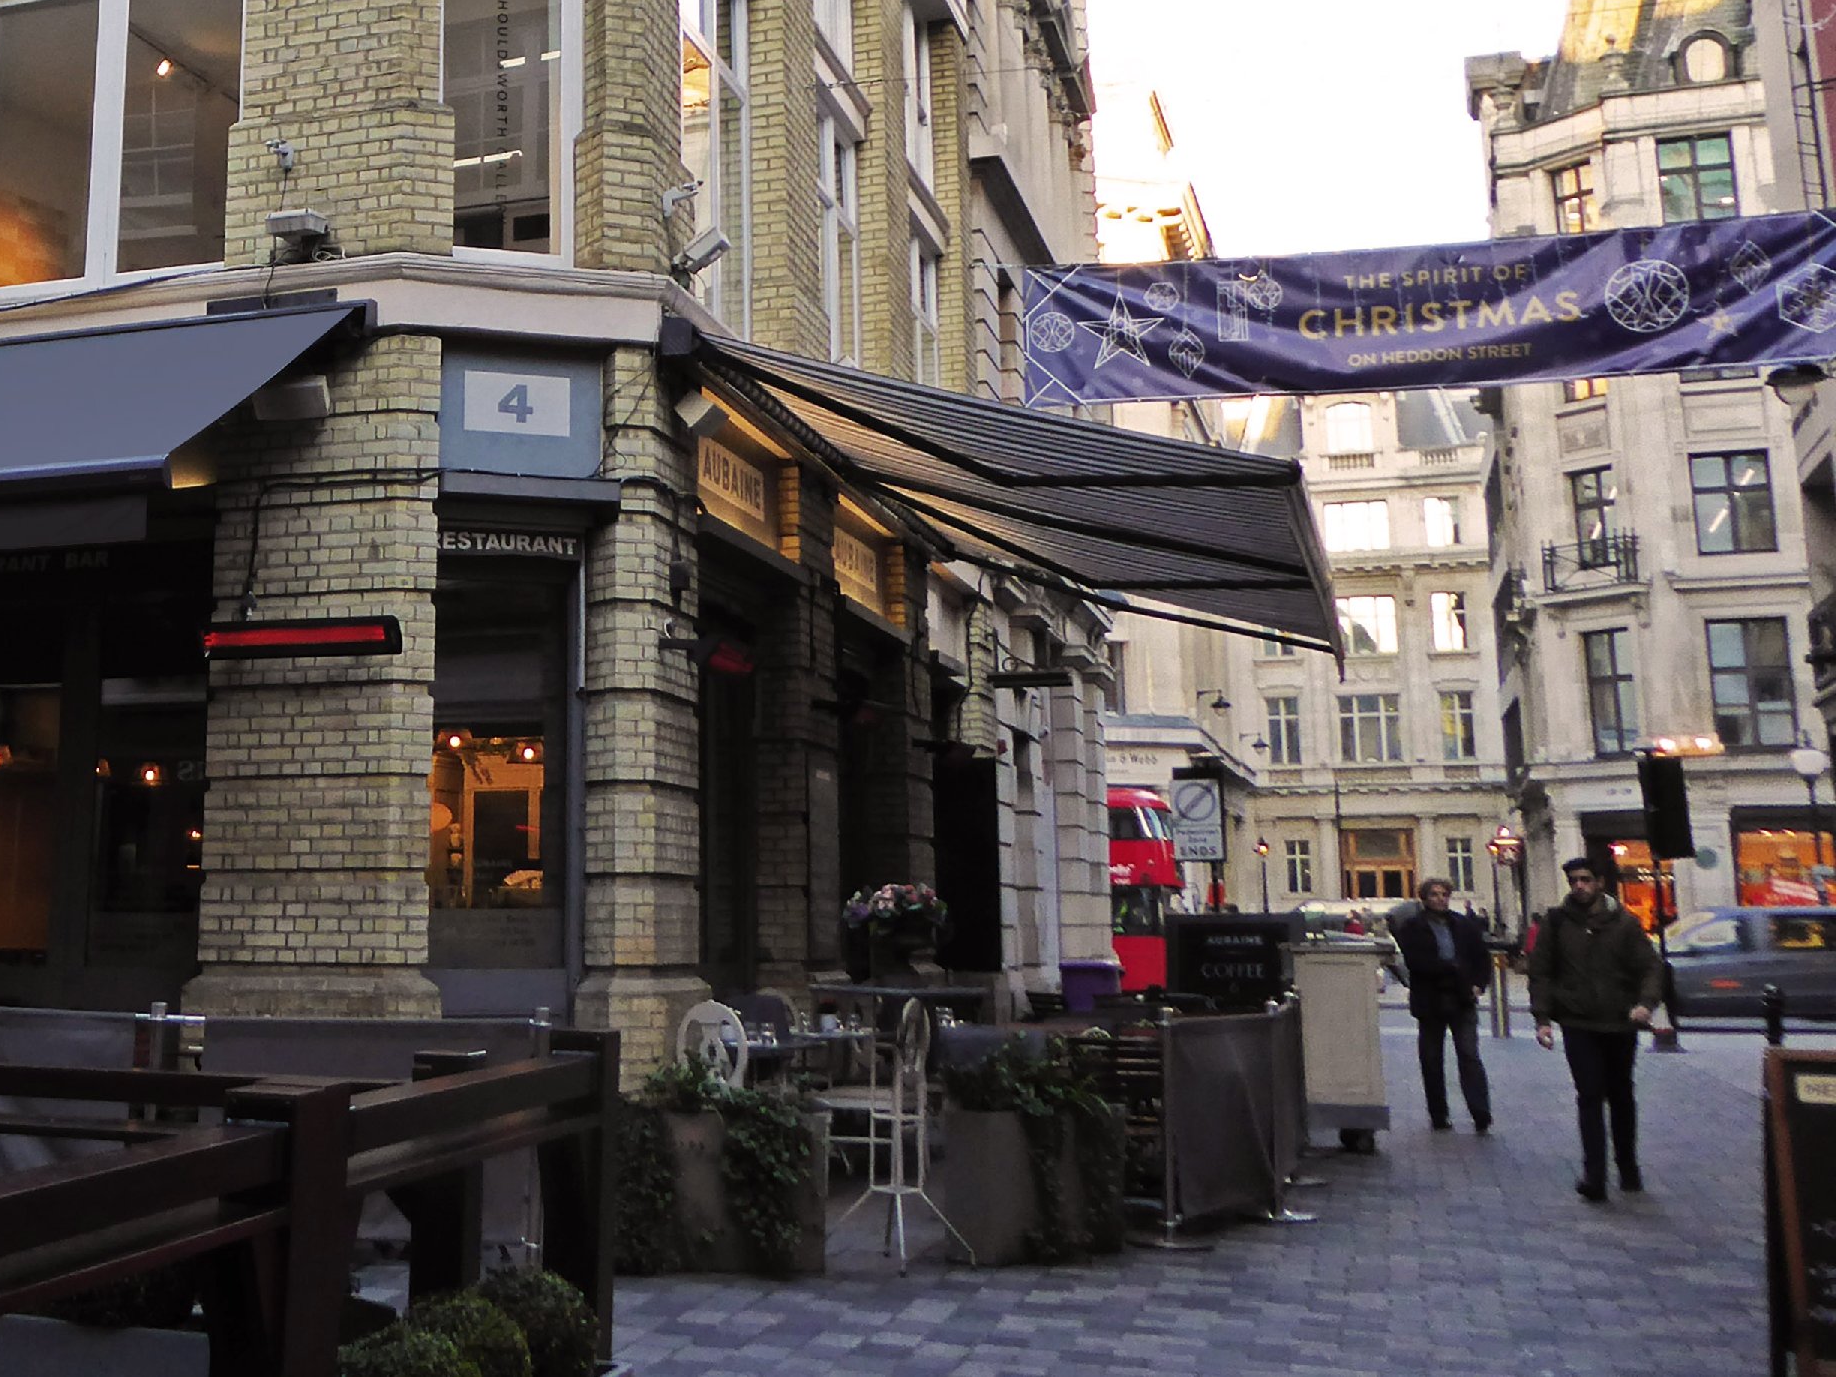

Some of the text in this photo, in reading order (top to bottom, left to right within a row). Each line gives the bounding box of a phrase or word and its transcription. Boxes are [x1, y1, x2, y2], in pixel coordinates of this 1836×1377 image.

[1344, 263, 1526, 290] THE SPIRIT OF
[1298, 290, 1581, 341] CHRISTMAS
[1347, 342, 1533, 367] ON HEDDON STREET
[497, 383, 534, 424] 4
[702, 446, 763, 511] AUBAINE
[64, 549, 109, 570] BAR
